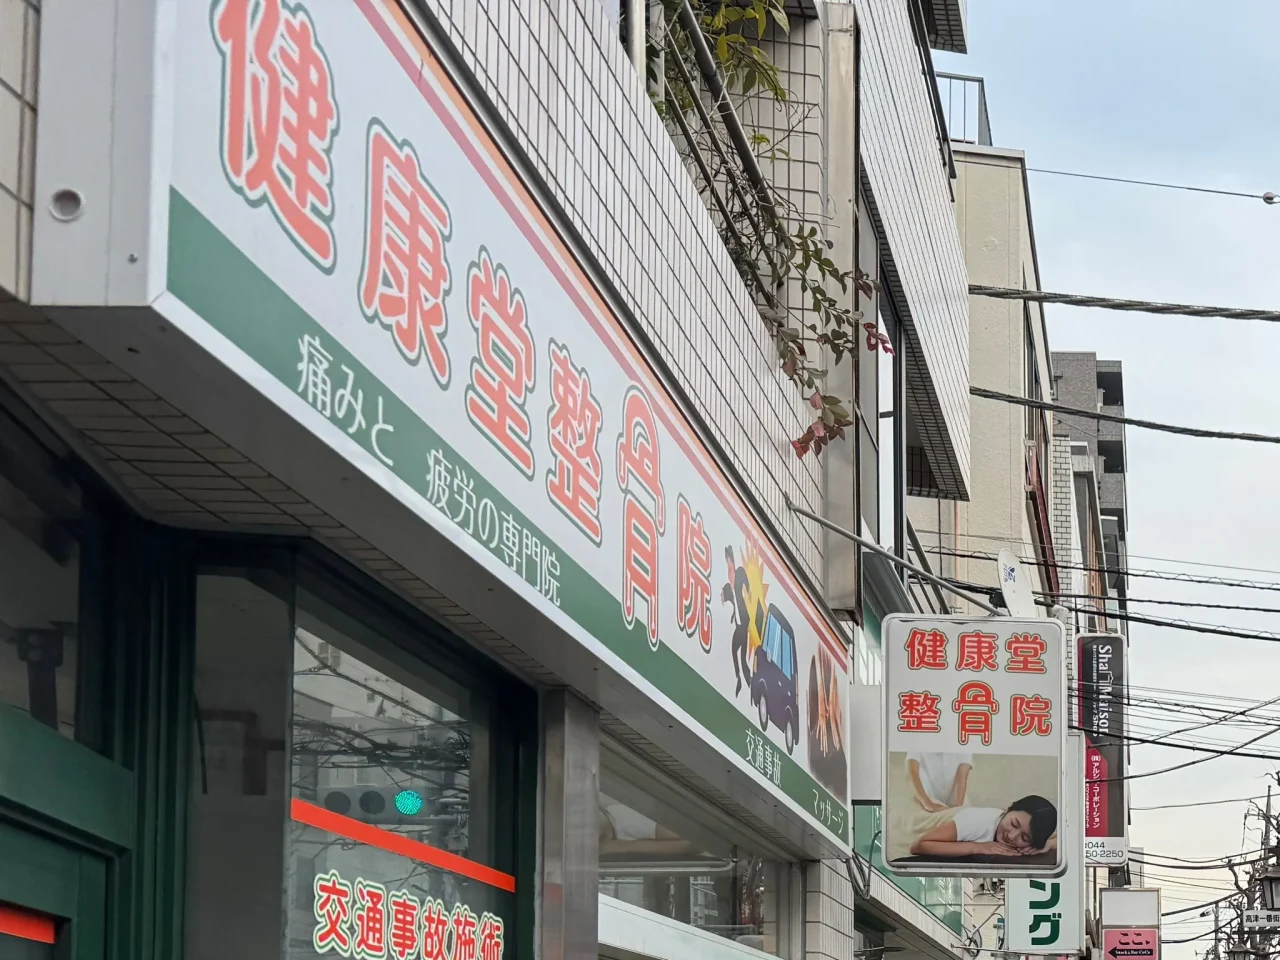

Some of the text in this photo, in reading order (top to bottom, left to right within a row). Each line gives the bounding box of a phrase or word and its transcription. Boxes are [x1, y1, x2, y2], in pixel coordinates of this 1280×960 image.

[211, 0, 714, 654] 健康堂整骨院
[295, 332, 563, 608] 痛みと 疲労の専門院
[904, 627, 1048, 675] 健康堂
[896, 679, 1053, 746] 整骨院
[745, 728, 782, 787] 交通事故
[812, 788, 844, 835] マッサージ
[1088, 841, 1105, 849] 044
[1245, 913, 1280, 923] 高津一番街
